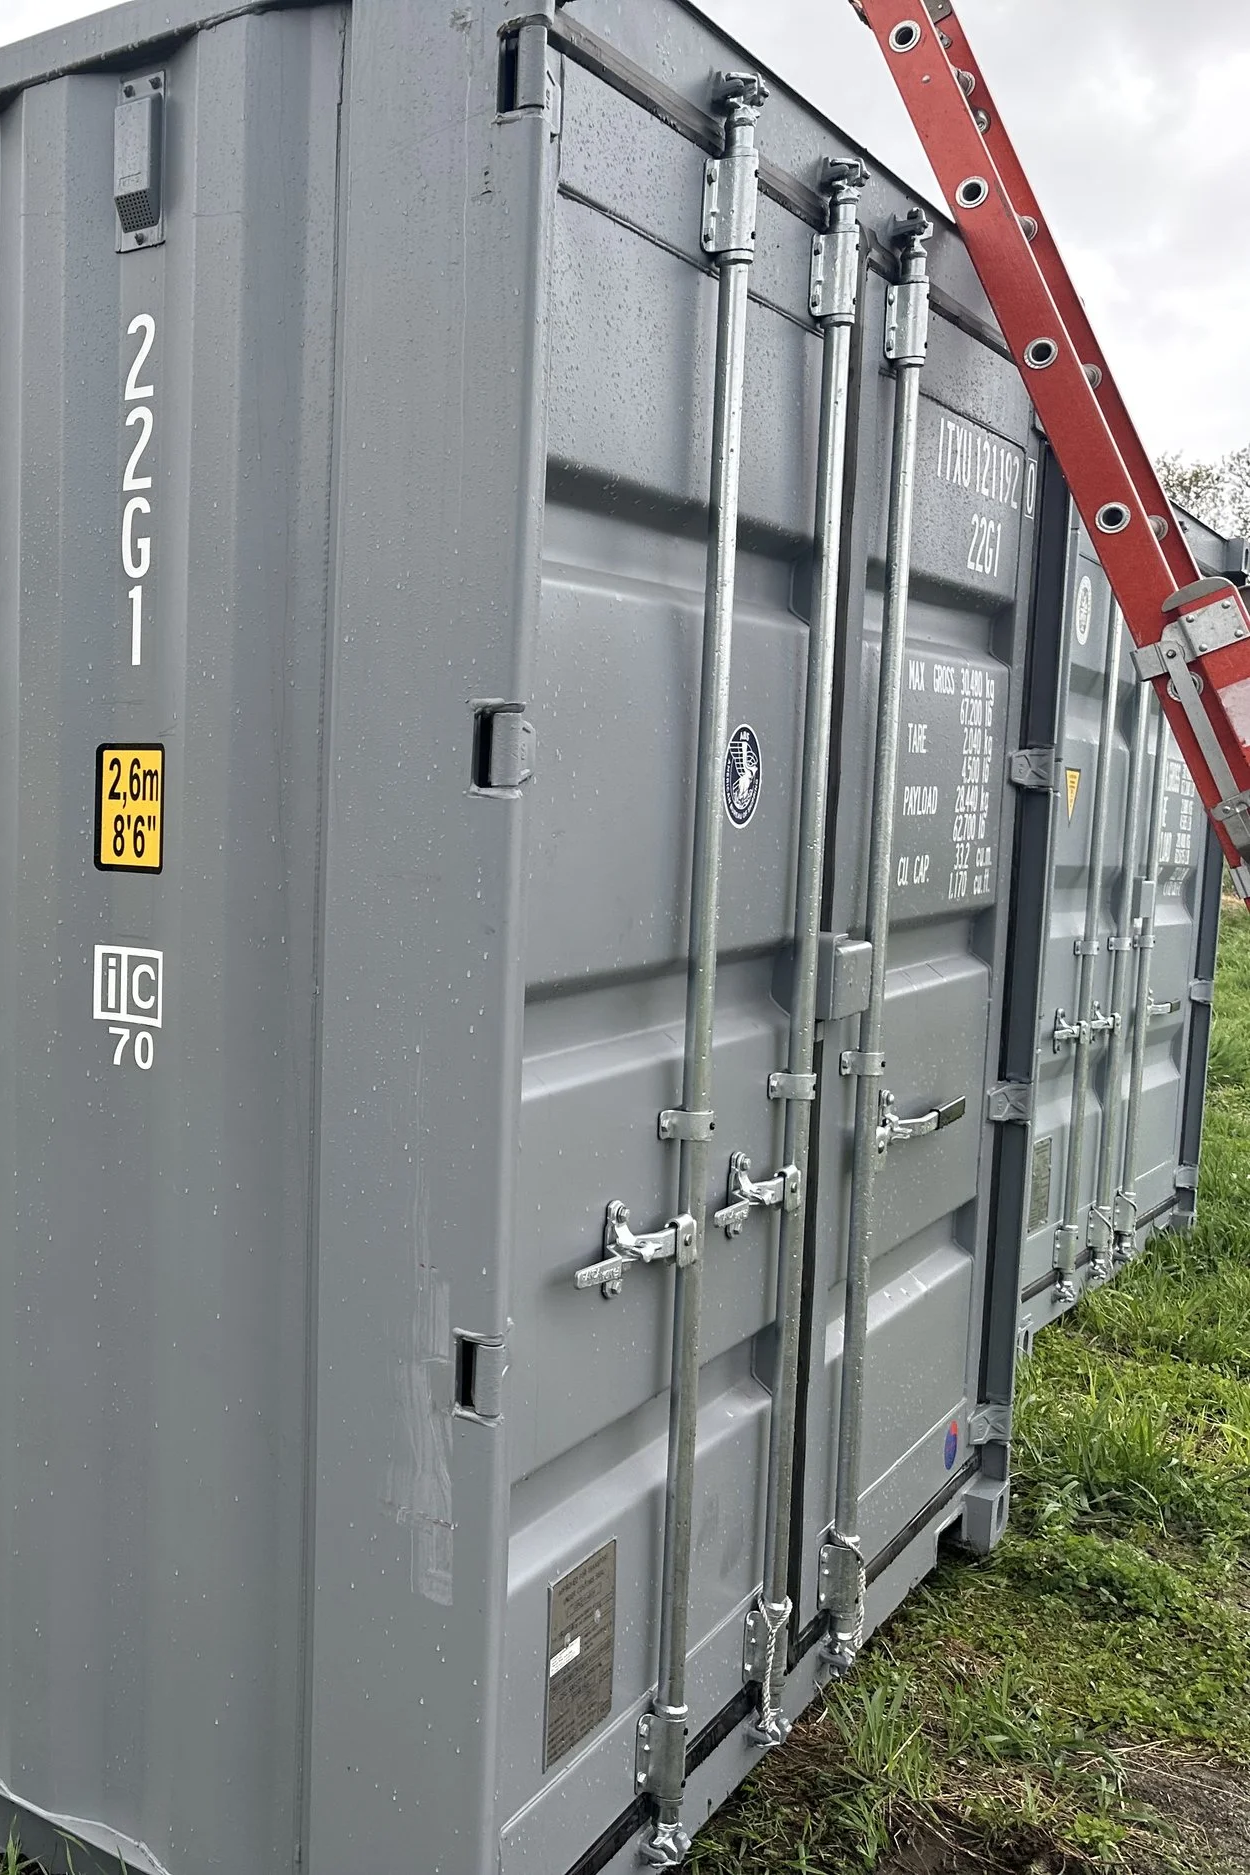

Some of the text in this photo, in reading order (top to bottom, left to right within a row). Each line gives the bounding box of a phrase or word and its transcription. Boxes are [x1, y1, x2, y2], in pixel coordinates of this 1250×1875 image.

[937, 417, 973, 488] ITXU
[975, 436, 1020, 510] 121192
[121, 313, 156, 666] 22G1
[966, 513, 1002, 577] 22G1
[908, 659, 925, 691] MAX
[933, 663, 955, 695] GROSS
[985, 671, 995, 706] kg
[908, 722, 928, 753] TARE
[983, 728, 993, 762] kg
[108, 757, 159, 809] 2,6m
[903, 785, 938, 816] PAYLOAD
[979, 785, 990, 818] kg
[112, 814, 156, 858] 8'6"
[108, 1026, 154, 1070] 70
